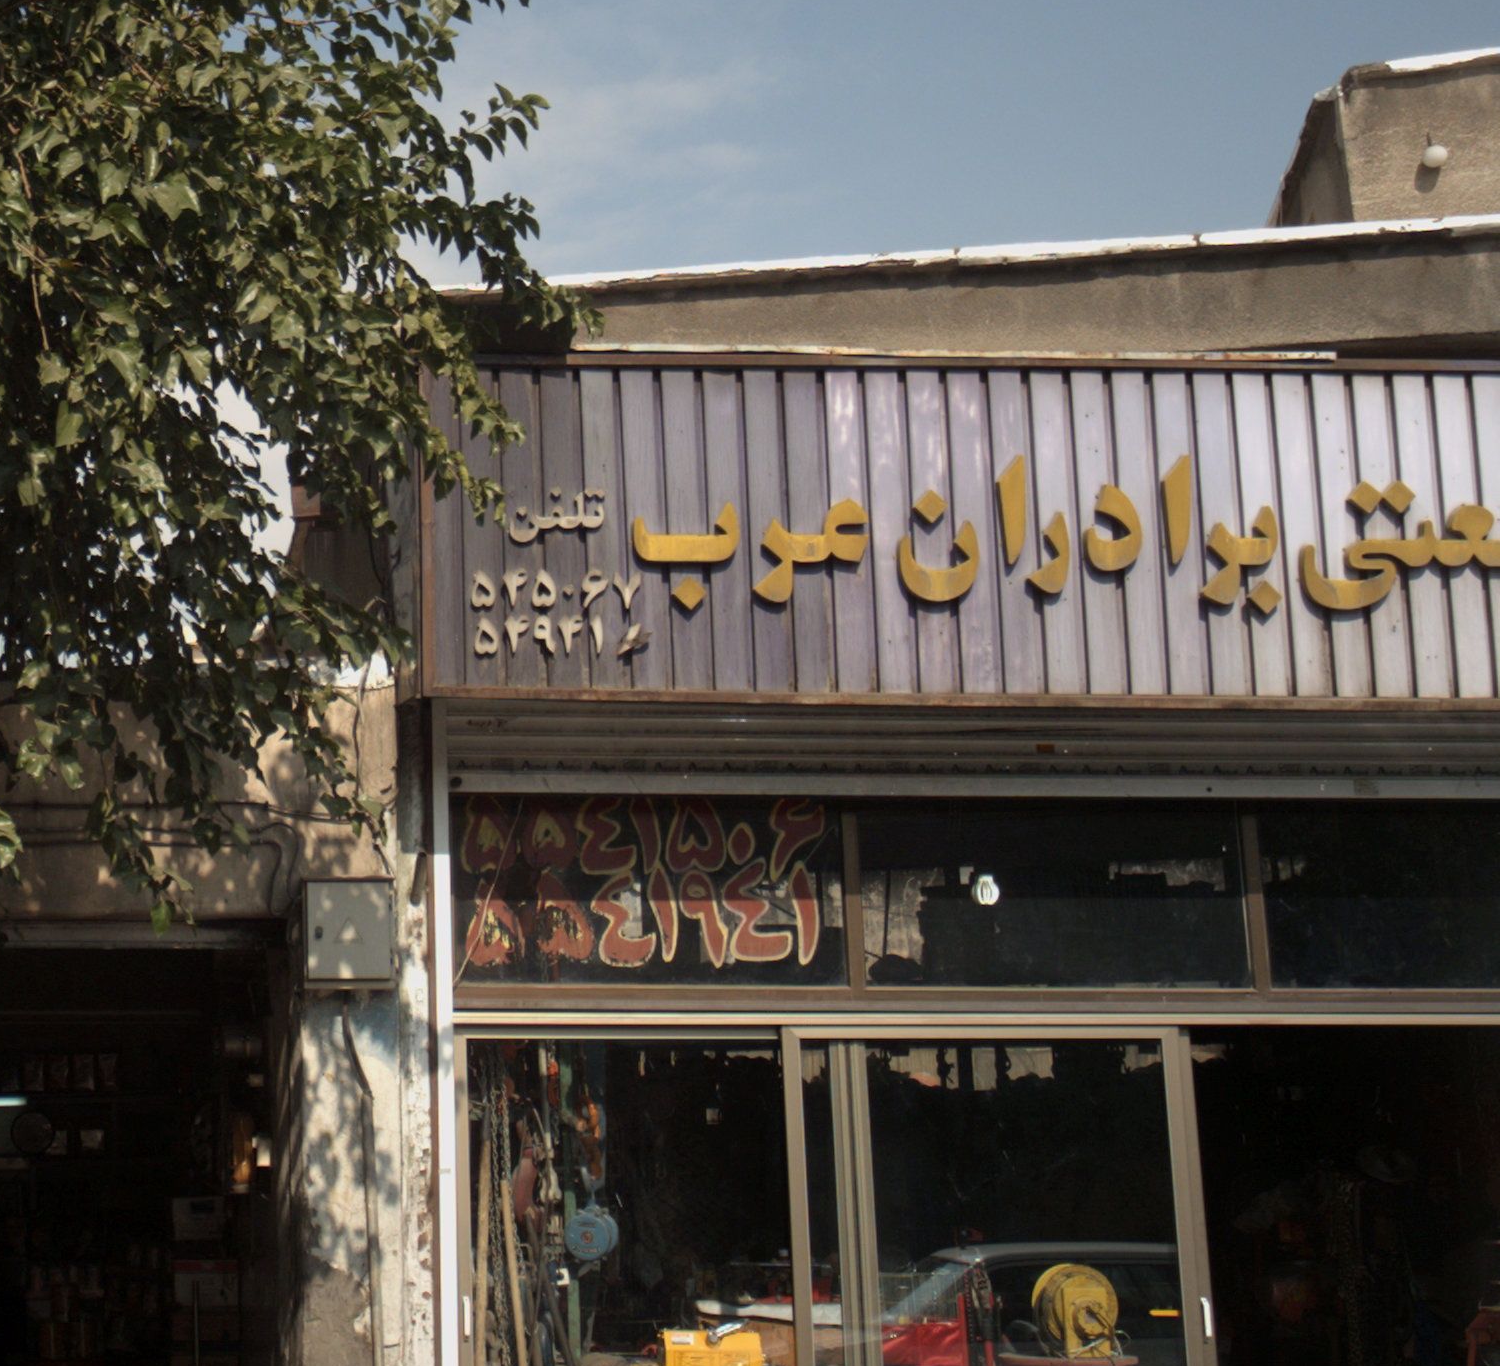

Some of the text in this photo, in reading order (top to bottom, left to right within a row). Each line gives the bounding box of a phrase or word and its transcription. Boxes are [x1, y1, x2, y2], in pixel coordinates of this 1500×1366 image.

[509, 486, 605, 543] تلفن
[633, 498, 869, 611] عرب
[897, 454, 1282, 615] برادران
